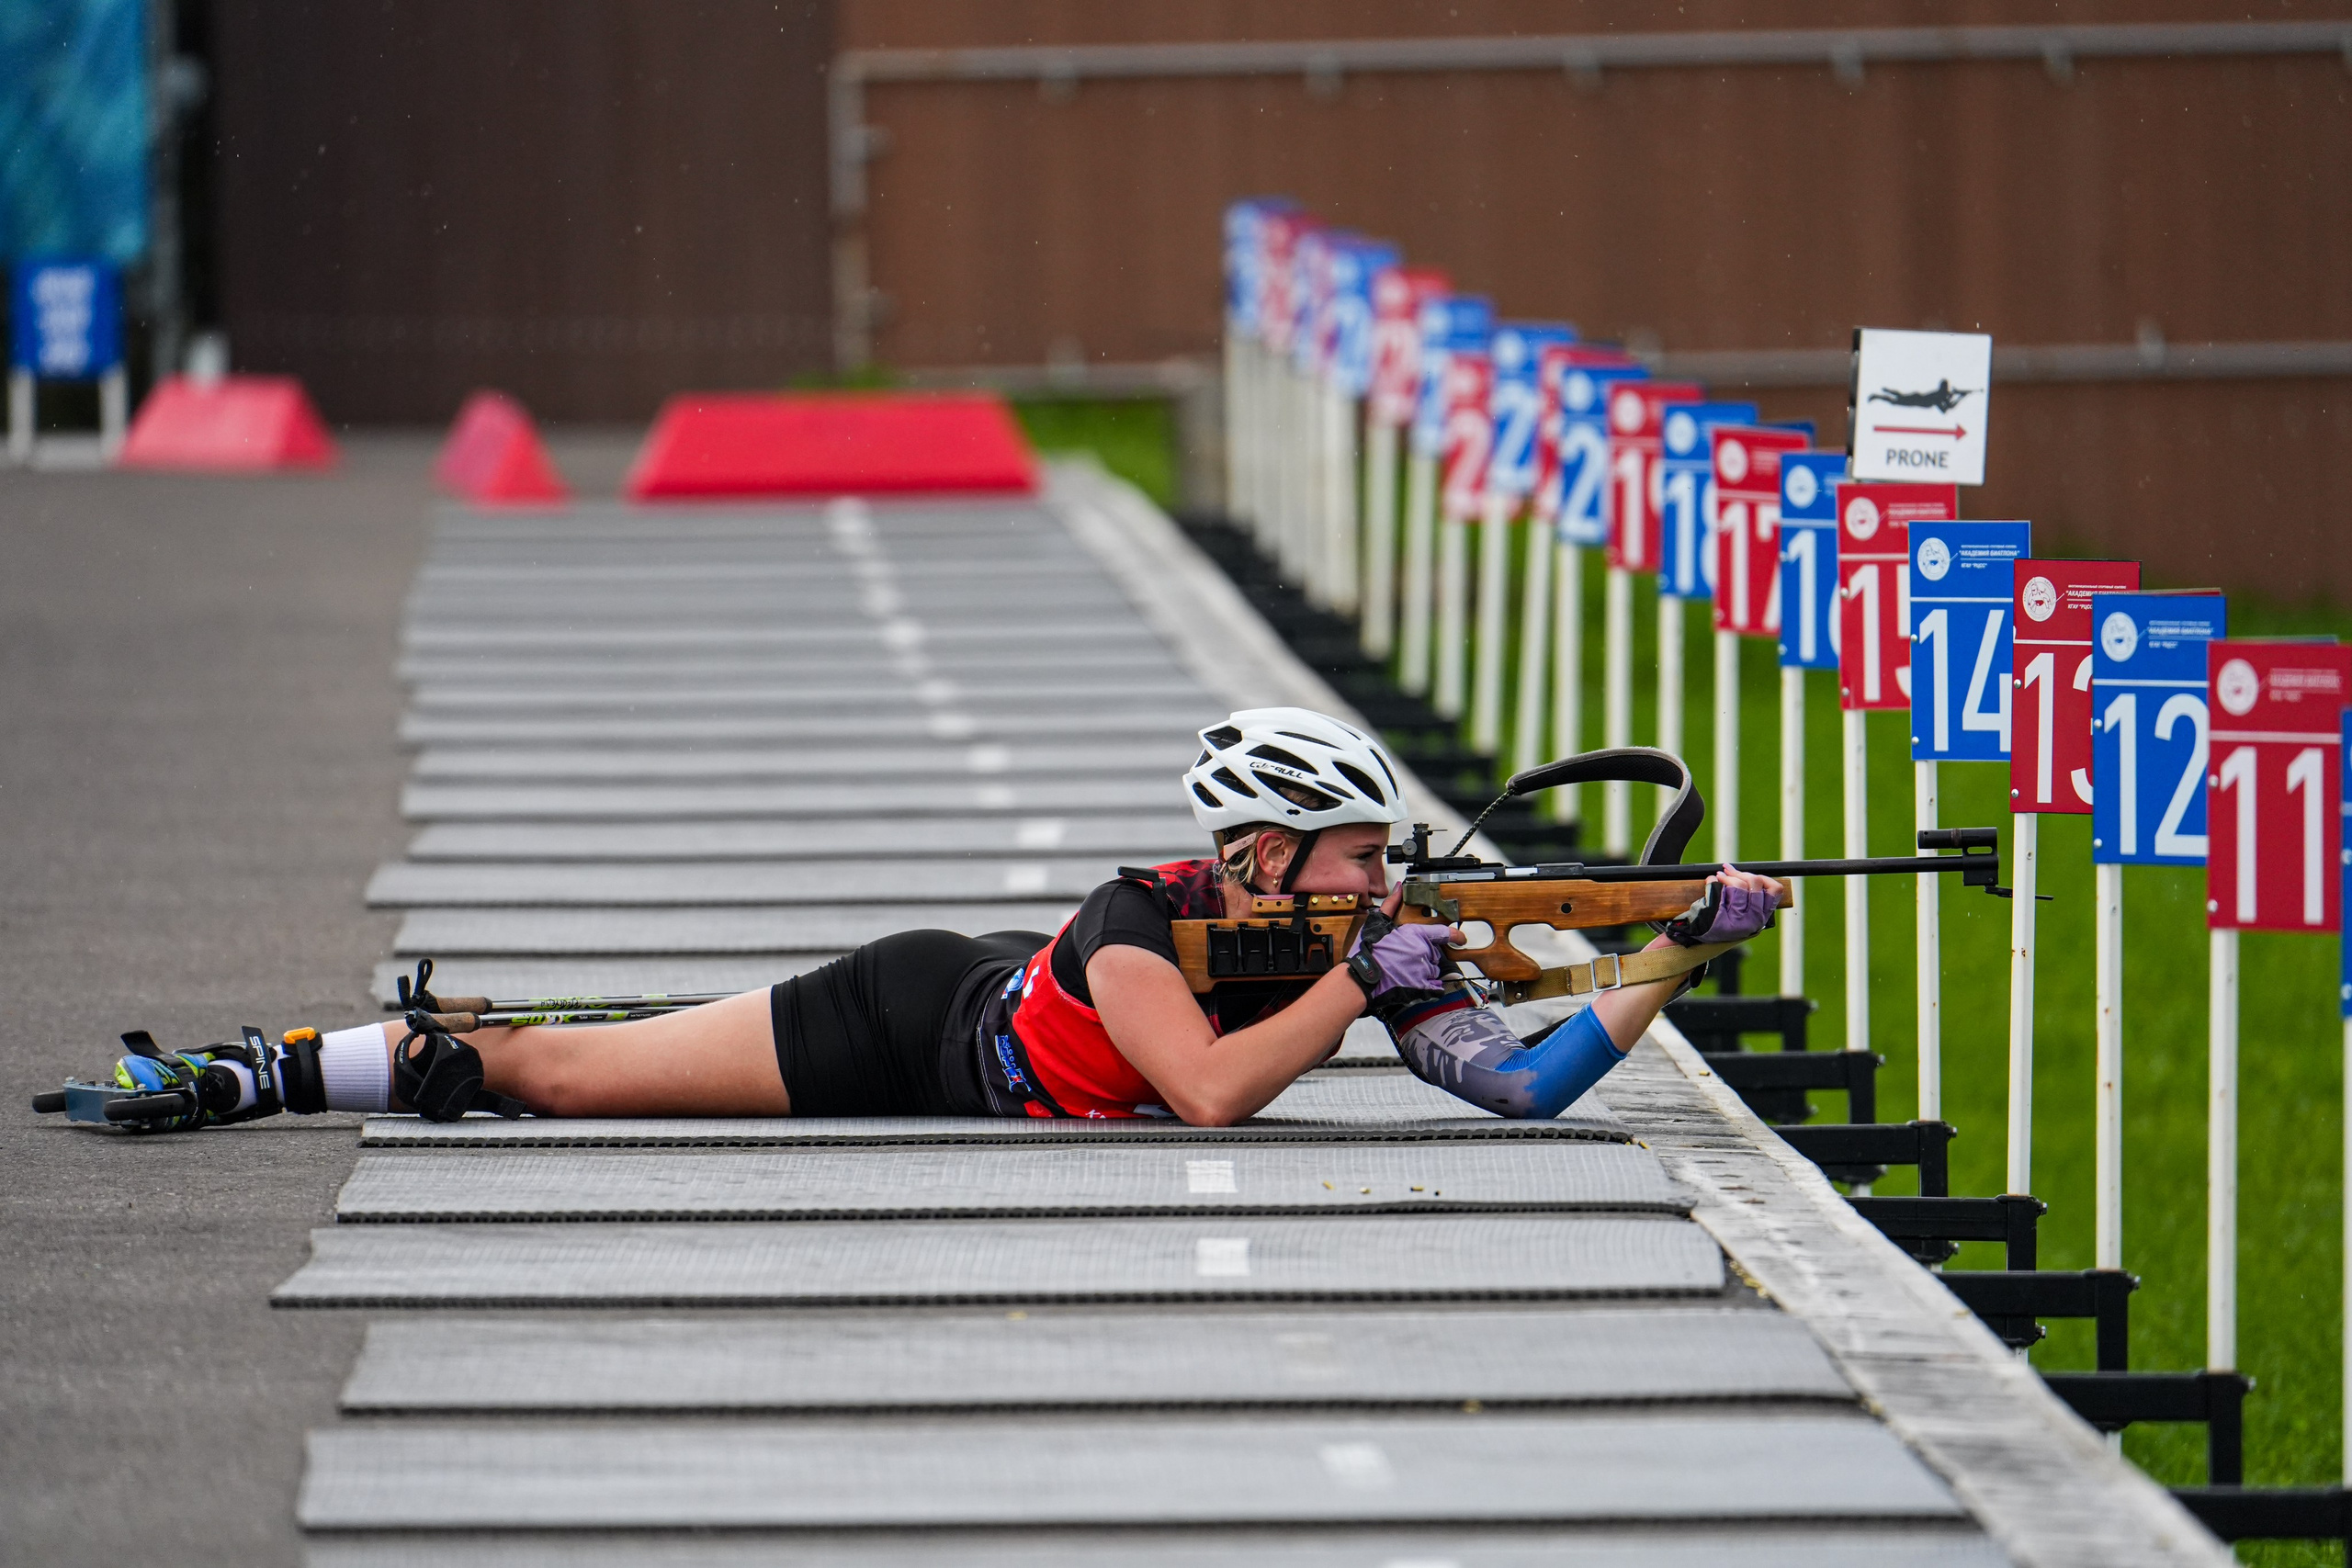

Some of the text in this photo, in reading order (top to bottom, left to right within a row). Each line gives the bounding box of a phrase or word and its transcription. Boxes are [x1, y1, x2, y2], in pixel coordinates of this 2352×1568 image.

[1560, 423, 1606, 539] 2
[1614, 448, 1663, 566] 1
[1886, 448, 1950, 468] PRONE
[1787, 529, 1839, 662] 1
[1919, 609, 2012, 752] 14
[2104, 693, 2209, 856] 12
[2220, 746, 2324, 925] 11
[249, 1035, 270, 1090] SPINE
